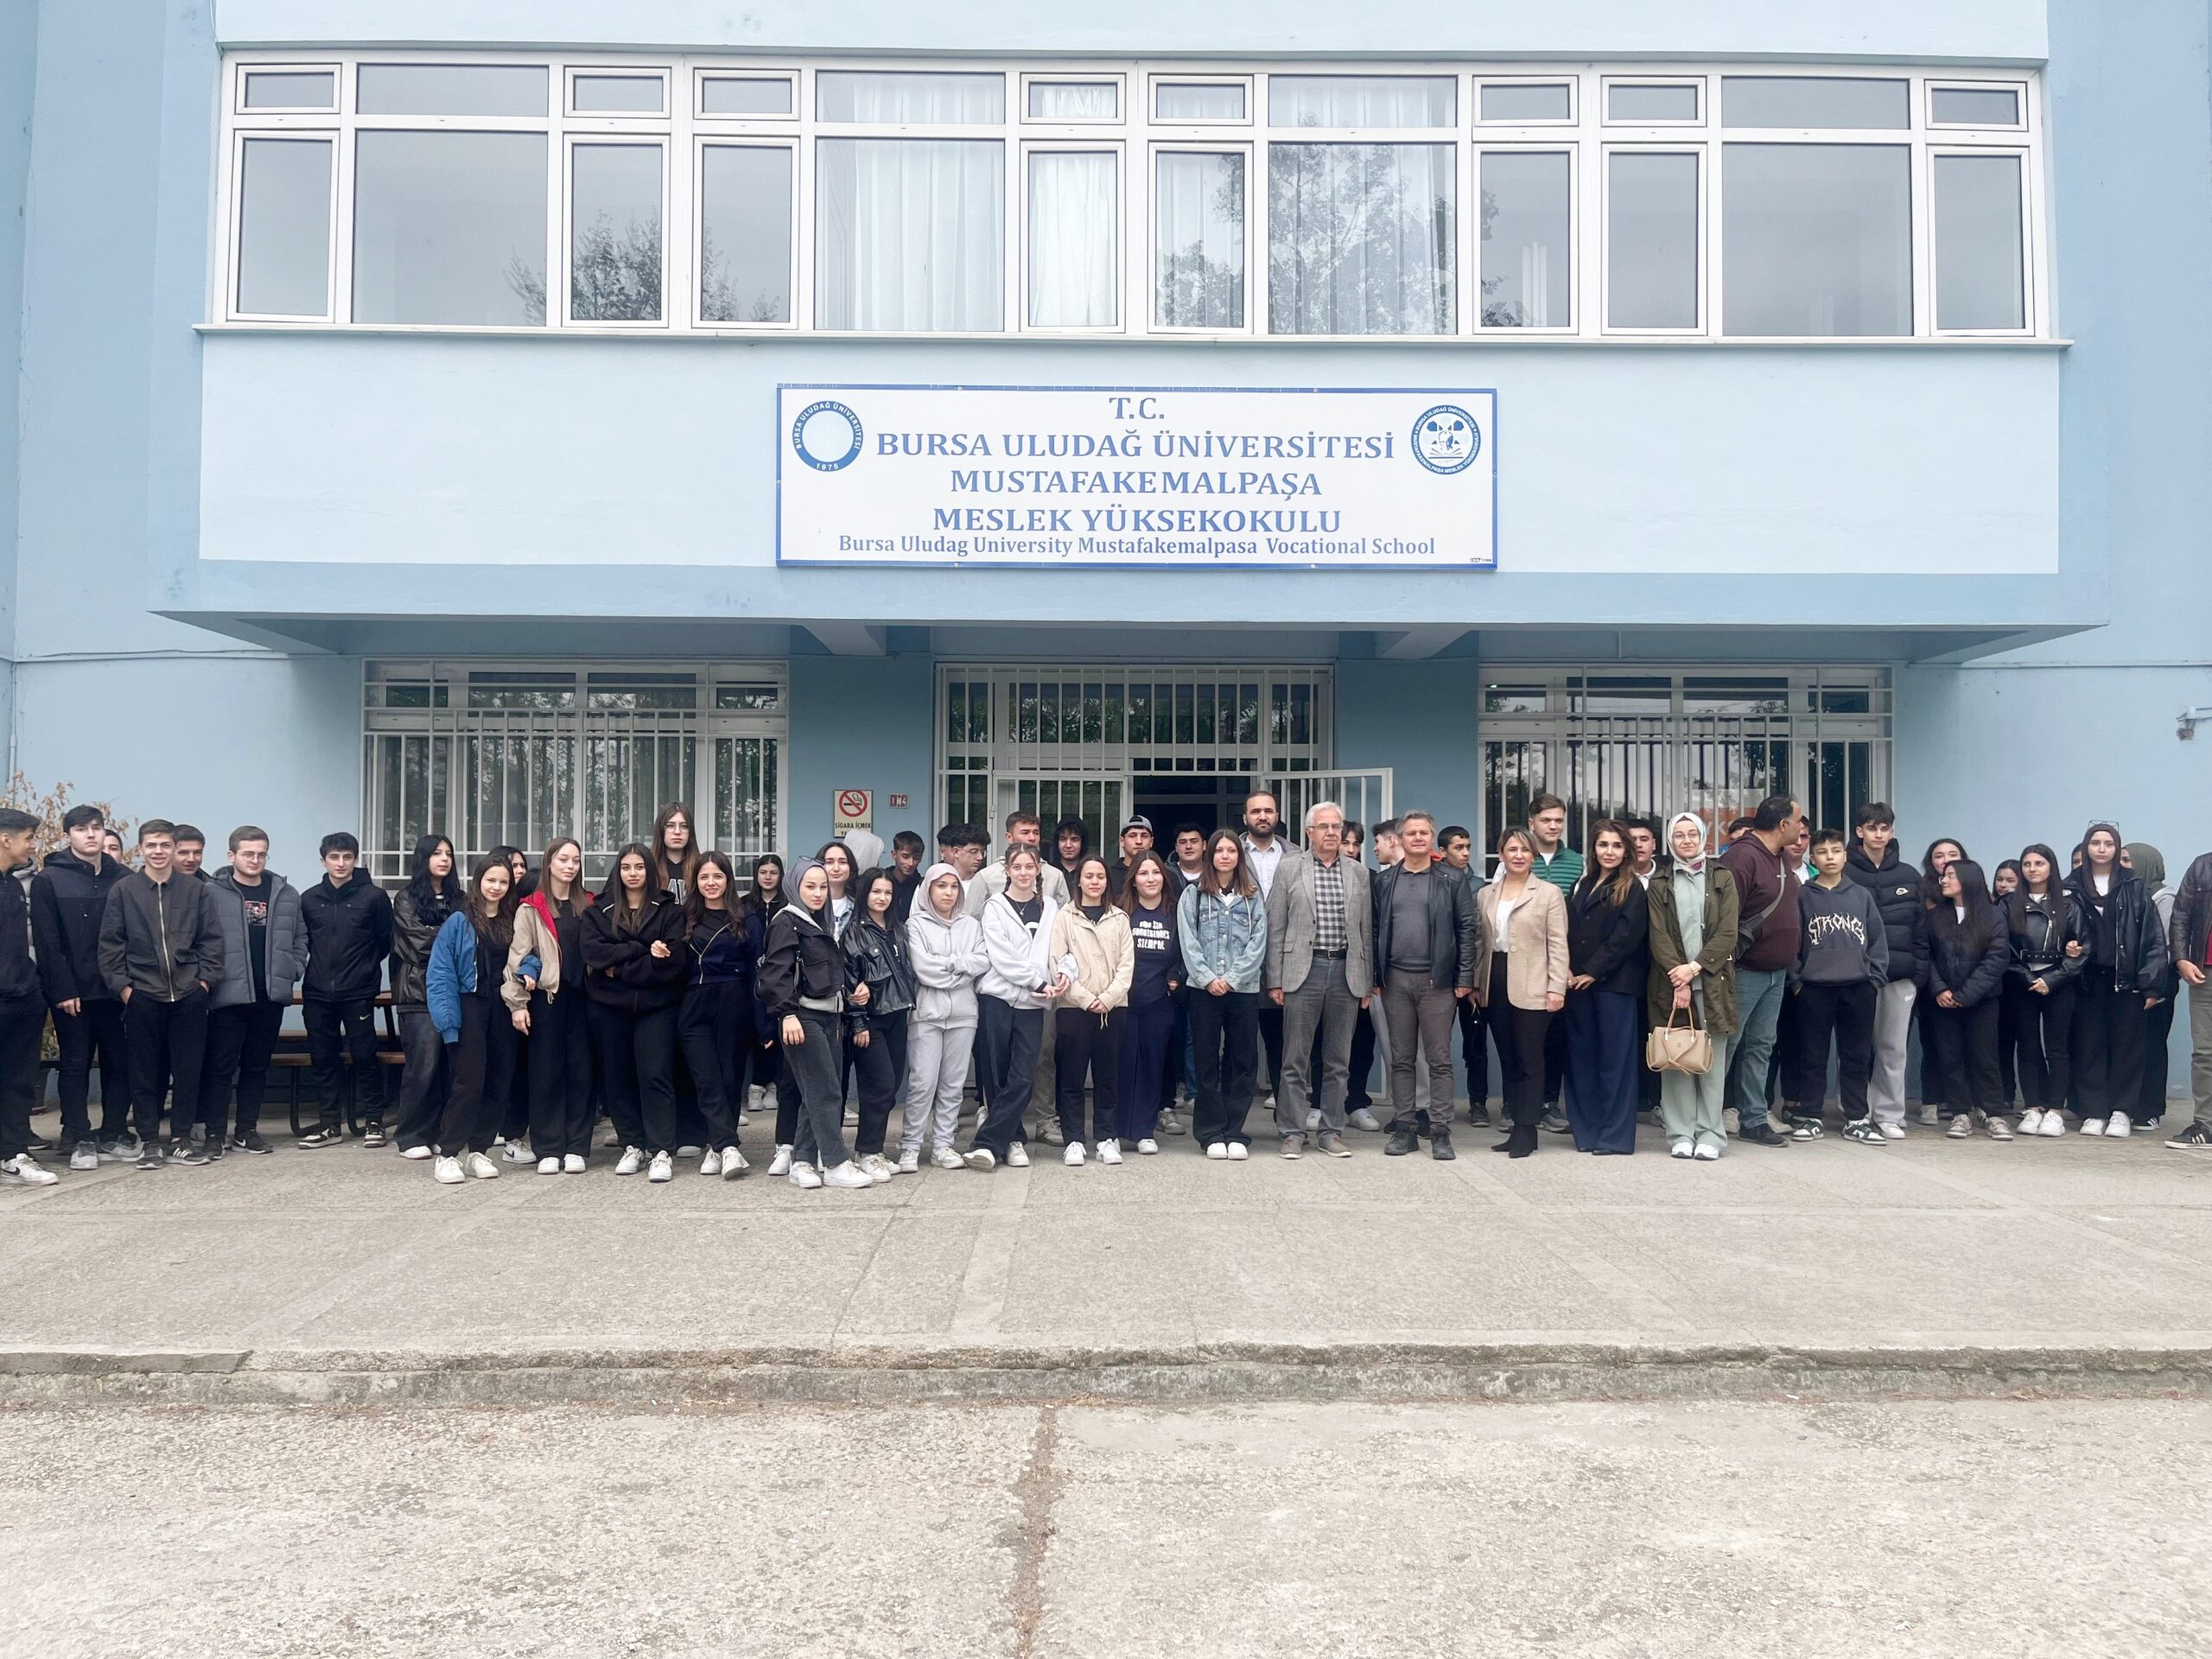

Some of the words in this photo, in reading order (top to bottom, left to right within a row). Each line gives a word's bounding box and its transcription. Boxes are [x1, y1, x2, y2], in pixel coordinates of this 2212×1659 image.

[800, 402, 830, 420] ULUDAĞ
[1109, 397, 1165, 419] T.C.
[876, 433, 993, 456] BURSA
[1001, 429, 1142, 457] ULUDAĞ
[1154, 430, 1395, 459] ÜNİVERSİTESİ
[950, 470, 1322, 501] MUSTAFAKEMALPAŞA
[933, 508, 1073, 531] MESLEK
[1082, 504, 1341, 532] YÜKSEKOKULU
[838, 536, 895, 551] Bursa
[900, 536, 969, 556] Uludag
[974, 537, 1073, 557] University
[1078, 537, 1257, 558] Mustafakemalpasa
[1266, 537, 1366, 554] Vocational
[1372, 538, 1435, 554] School
[1808, 912, 1866, 945] STRONG
[1137, 938, 1166, 950] SIEMPRE
